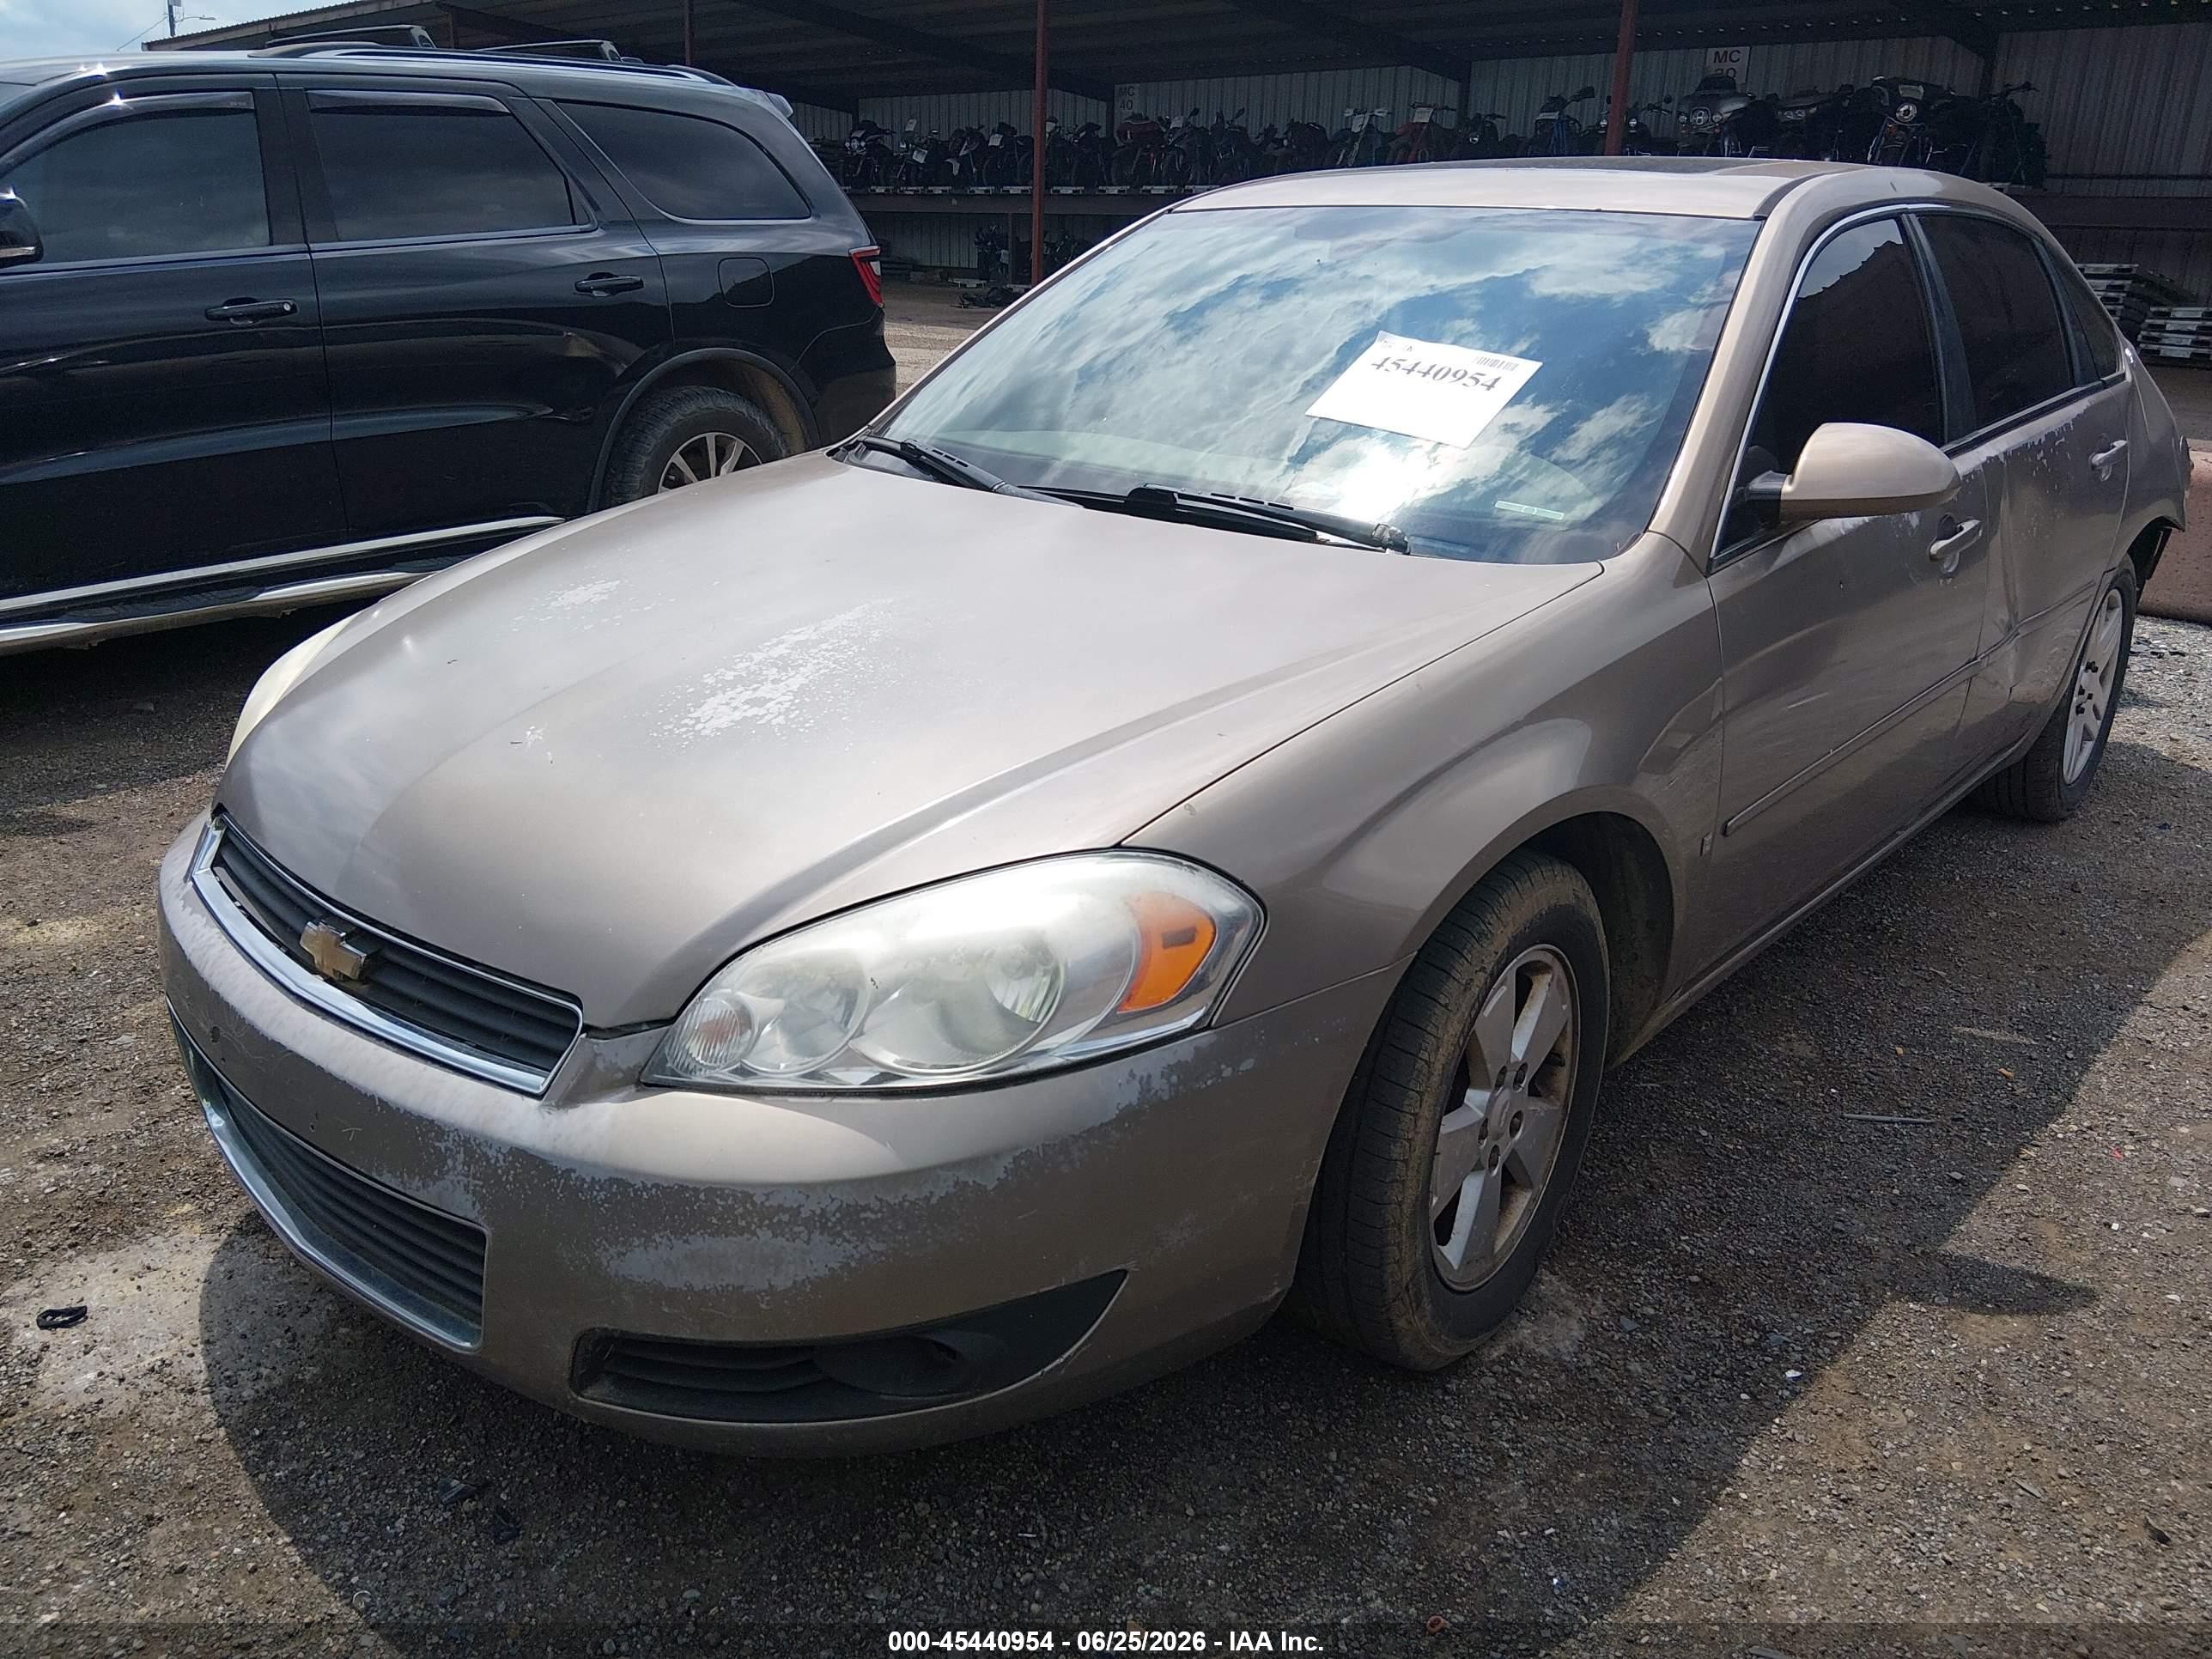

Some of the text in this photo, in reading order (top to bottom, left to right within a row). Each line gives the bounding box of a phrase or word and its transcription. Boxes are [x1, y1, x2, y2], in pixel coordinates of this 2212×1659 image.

[1713, 50, 1741, 64] MC
[1119, 86, 1135, 96] MC
[1119, 100, 1133, 110] 40
[1371, 356, 1502, 392] 45440954
